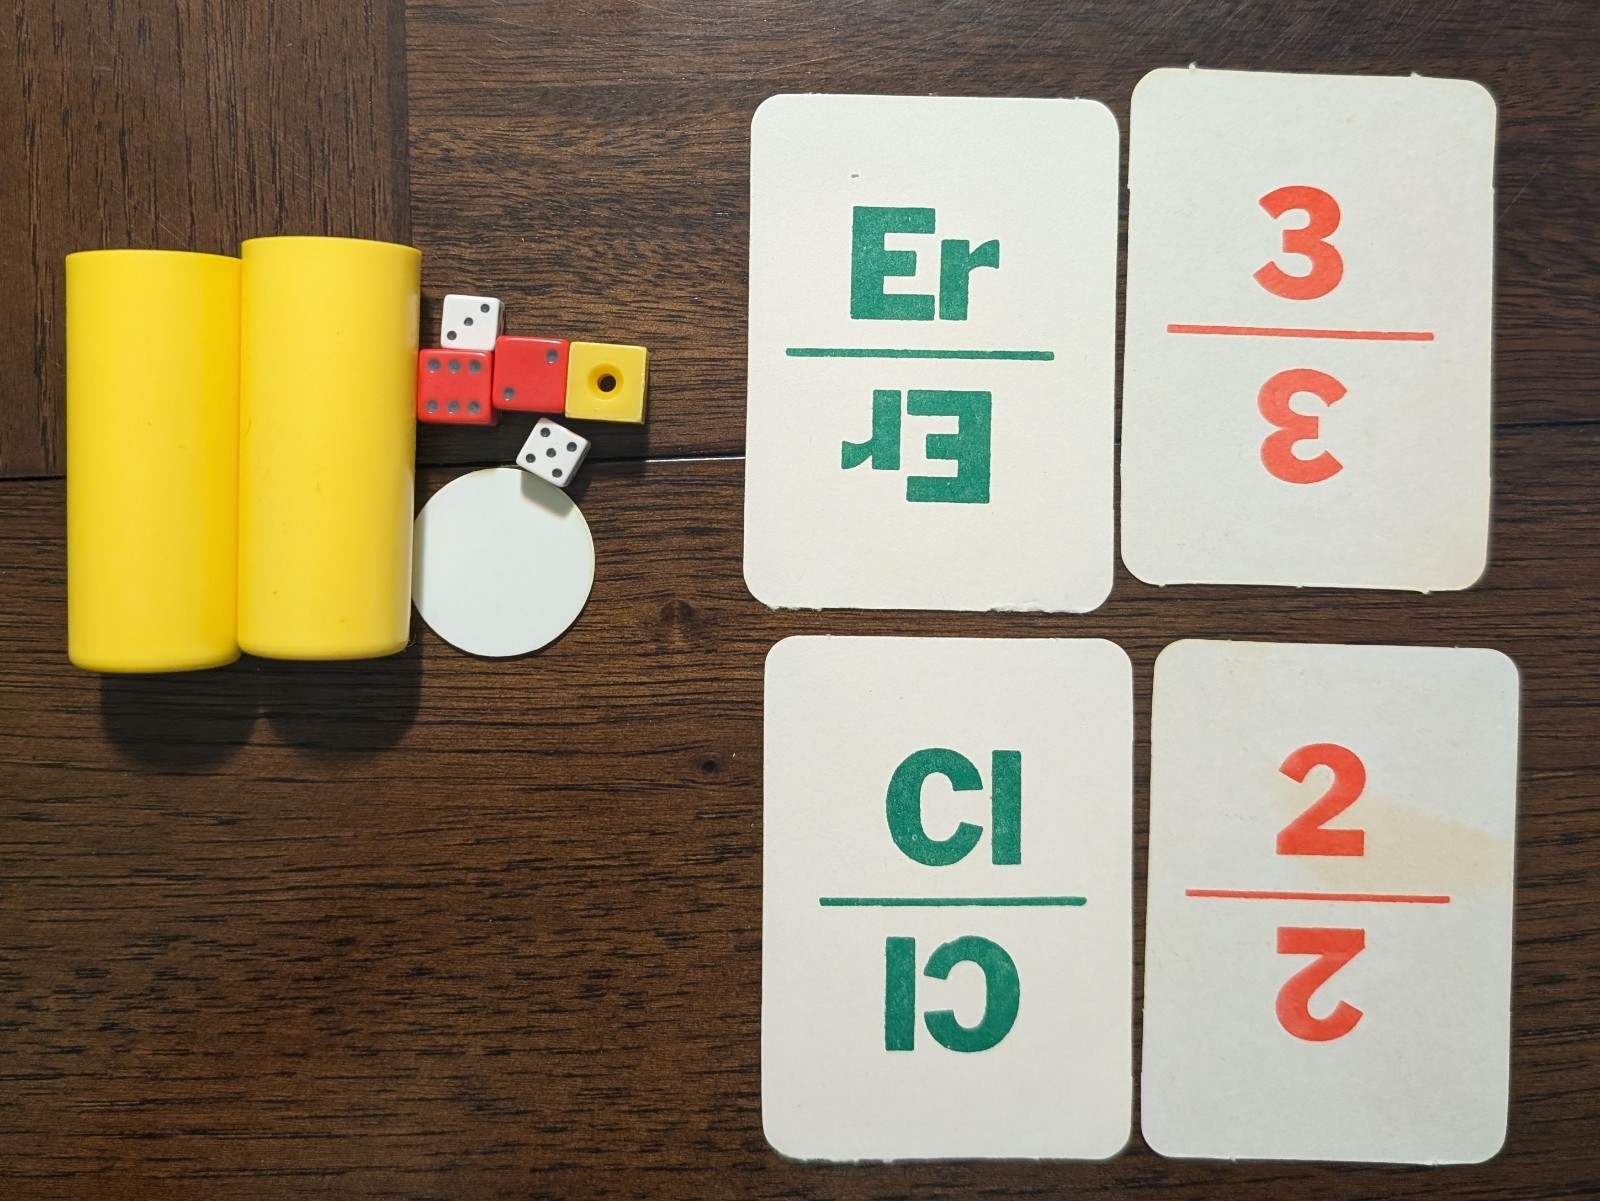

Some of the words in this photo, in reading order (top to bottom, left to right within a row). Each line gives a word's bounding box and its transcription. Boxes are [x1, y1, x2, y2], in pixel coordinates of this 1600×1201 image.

[850, 206, 1000, 321] Er
[1255, 185, 1344, 301] 3
[841, 389, 992, 504] Er
[1257, 368, 1348, 485] 3
[886, 748, 1022, 867] Cl
[1277, 743, 1367, 857] 2
[885, 936, 1020, 1053] Cl
[1276, 927, 1366, 1042] 2
